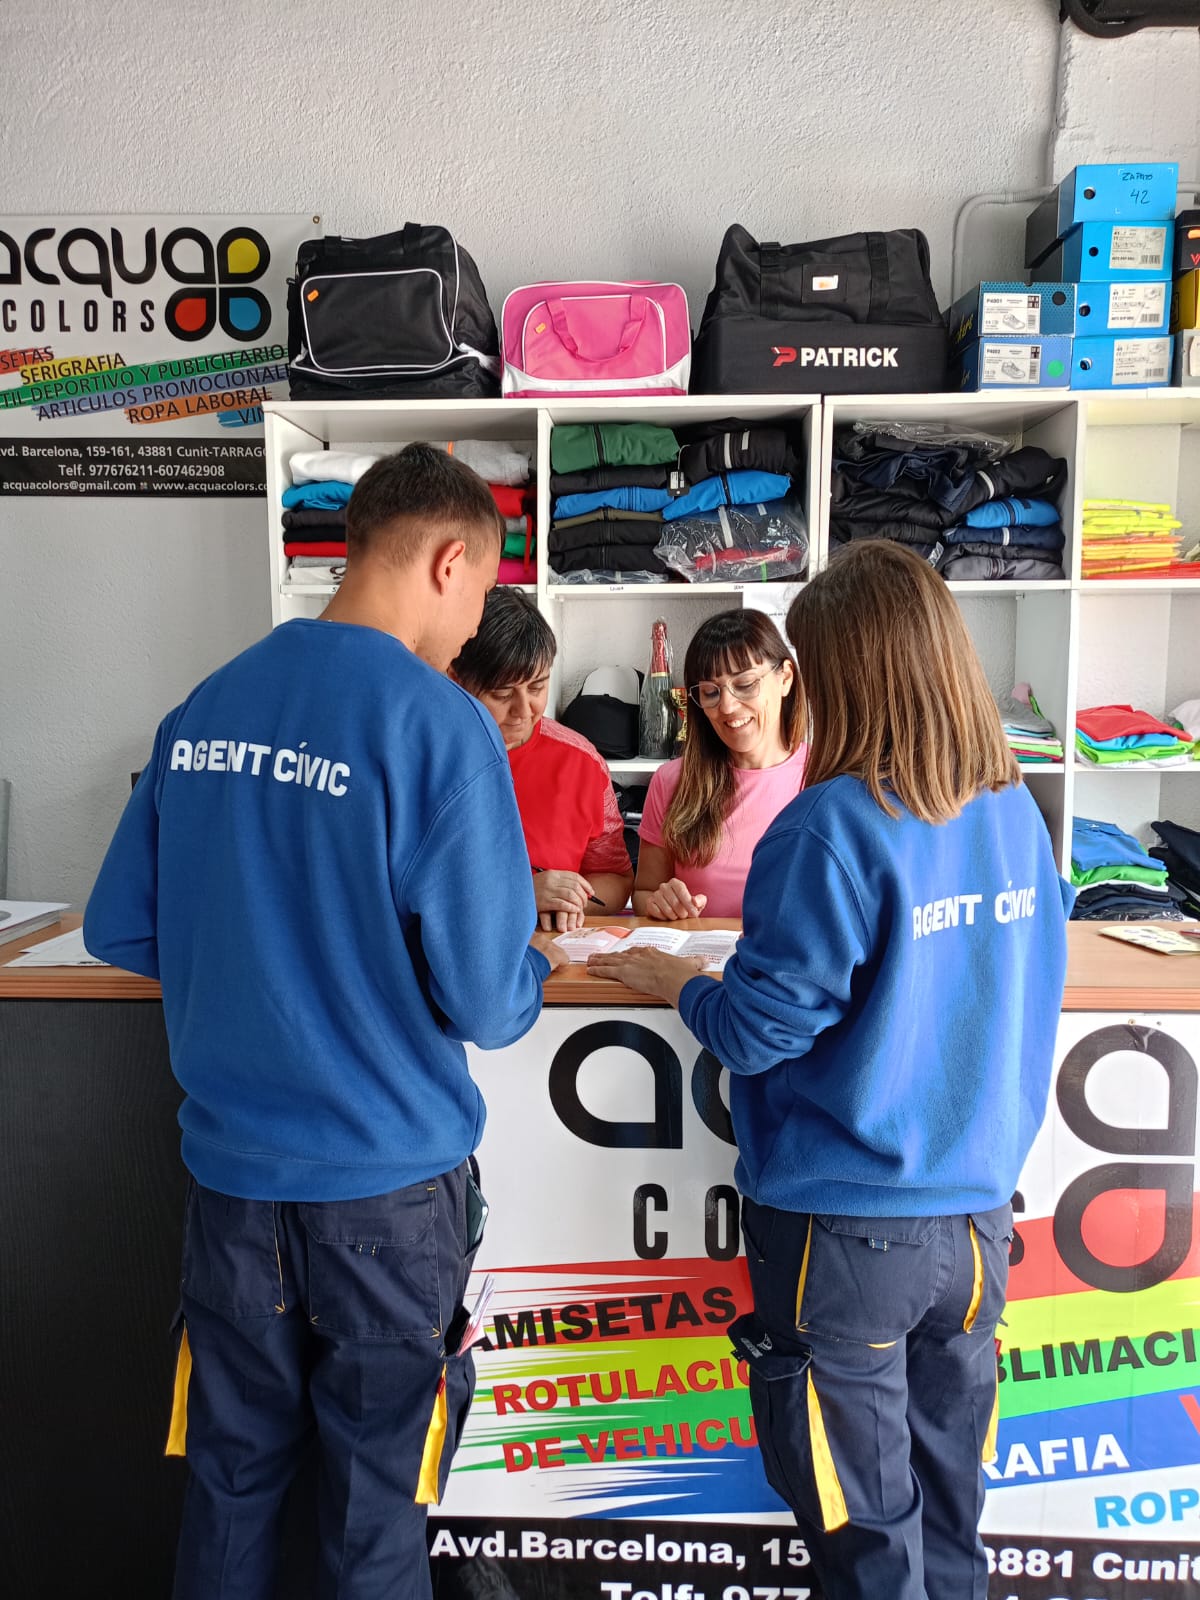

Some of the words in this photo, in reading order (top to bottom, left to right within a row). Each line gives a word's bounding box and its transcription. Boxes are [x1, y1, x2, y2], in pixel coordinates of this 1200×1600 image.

[1130, 188, 1151, 204] 42
[3, 299, 155, 333] COLORS
[20, 352, 126, 386] SERIGRAFIA
[30, 369, 134, 403] DEPORTIVO
[140, 365, 151, 383] Y
[158, 344, 285, 380] PUBLICITARIO
[801, 347, 899, 367] PATRICK
[38, 389, 137, 421] ARTICULOS
[128, 401, 180, 424] ROPA
[185, 386, 273, 413] LABORAL
[0, 445, 19, 457] vd.
[22, 446, 82, 458] Barcelona,
[86, 446, 134, 458] 159-161,
[137, 446, 172, 457] 43881
[2, 480, 136, 492] acquacolors@gmail.com
[58, 464, 86, 476] Telf.
[89, 464, 225, 477] 977676211-607462908
[170, 739, 272, 776] AGENT
[273, 741, 350, 797] CÍVIC
[912, 894, 983, 941] AGENT
[994, 880, 1035, 924] CÍVIC
[502, 1437, 566, 1473] DE
[429, 1529, 746, 1571] Avd.Barcelona,
